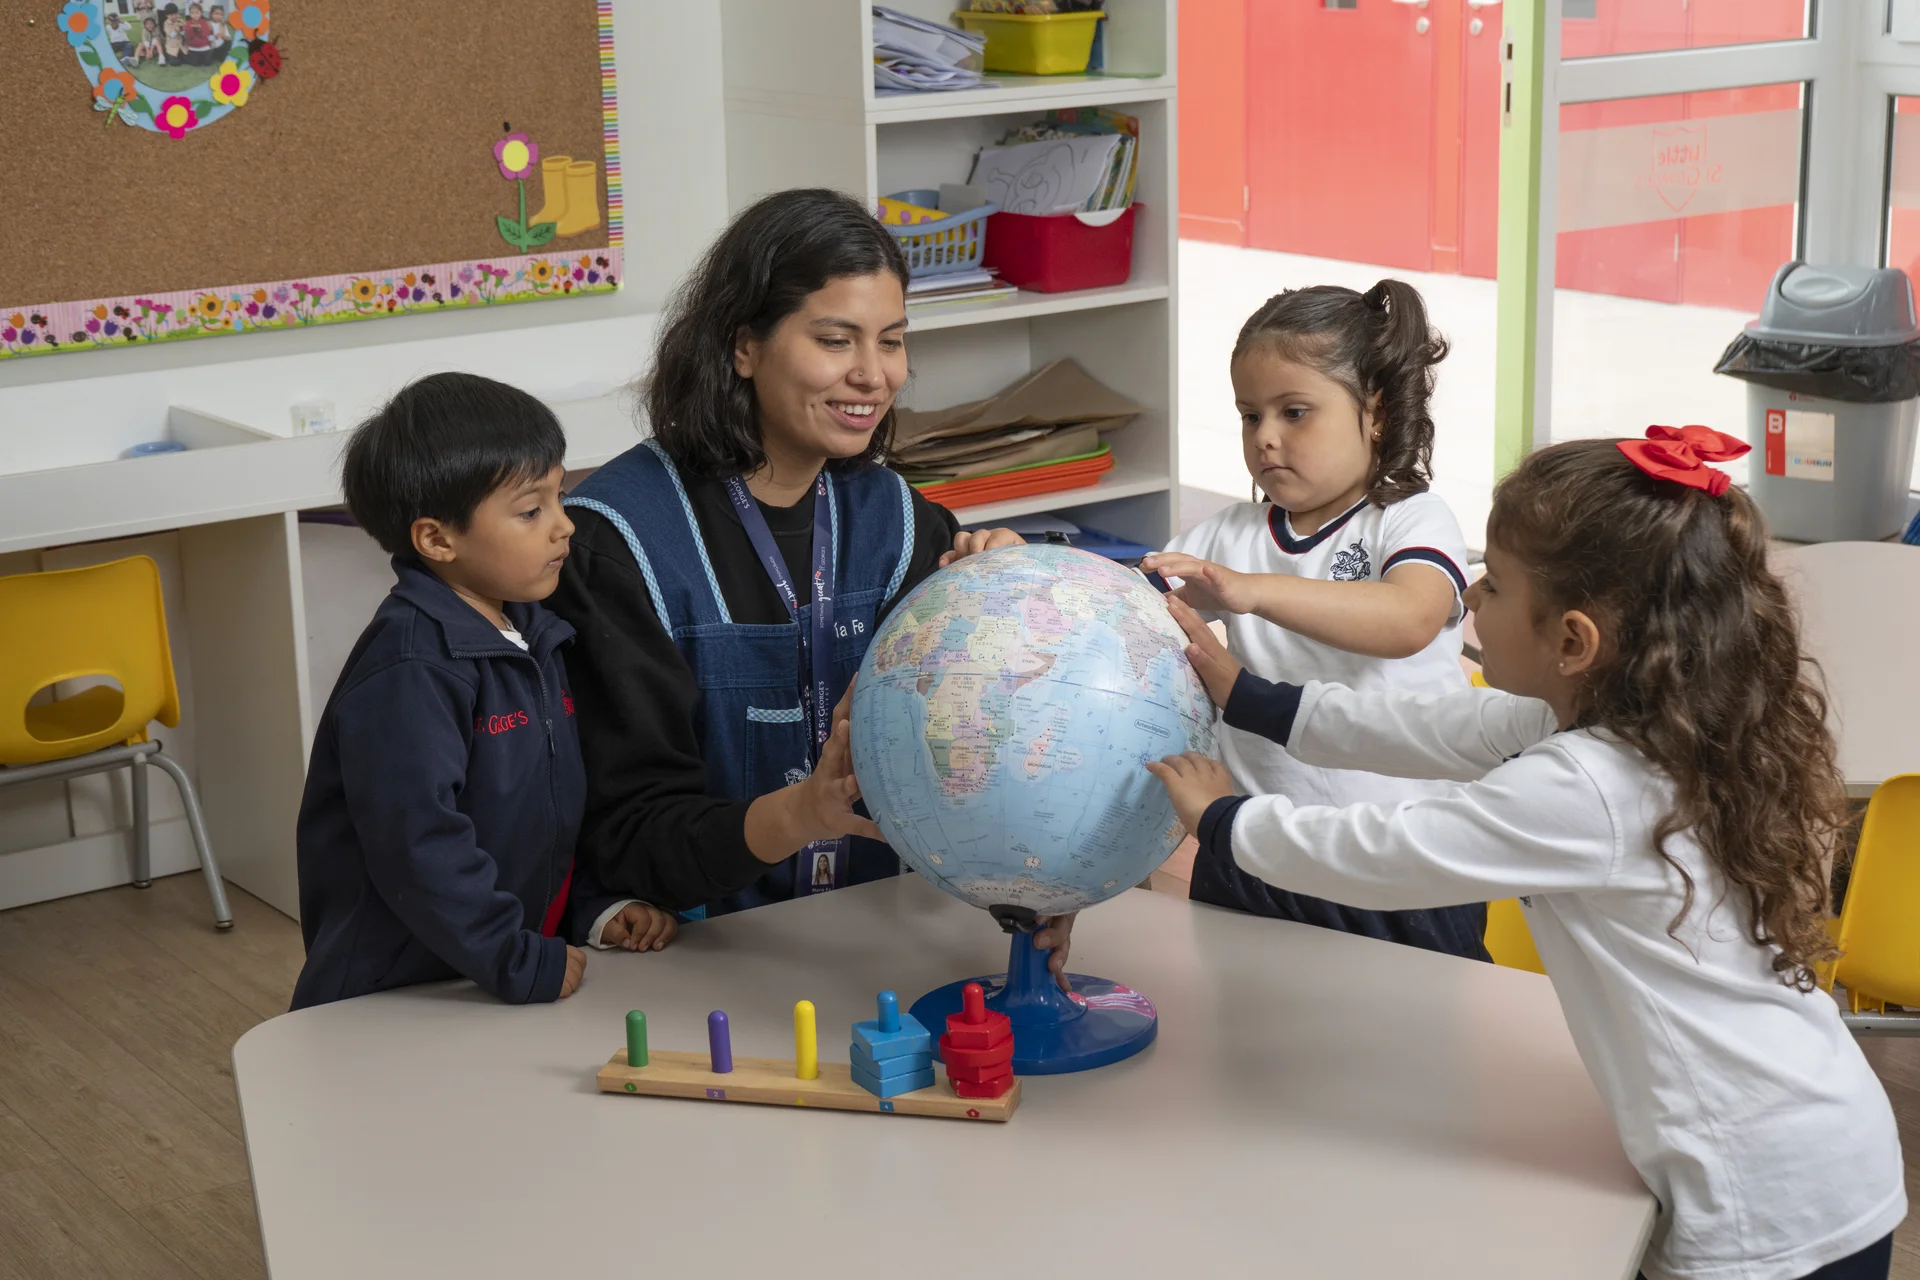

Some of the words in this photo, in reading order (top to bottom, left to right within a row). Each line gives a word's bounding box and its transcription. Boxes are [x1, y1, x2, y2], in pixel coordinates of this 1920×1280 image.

[1768, 412, 1784, 434] B
[851, 618, 865, 635] Fe
[817, 680, 827, 717] GEORGE'S
